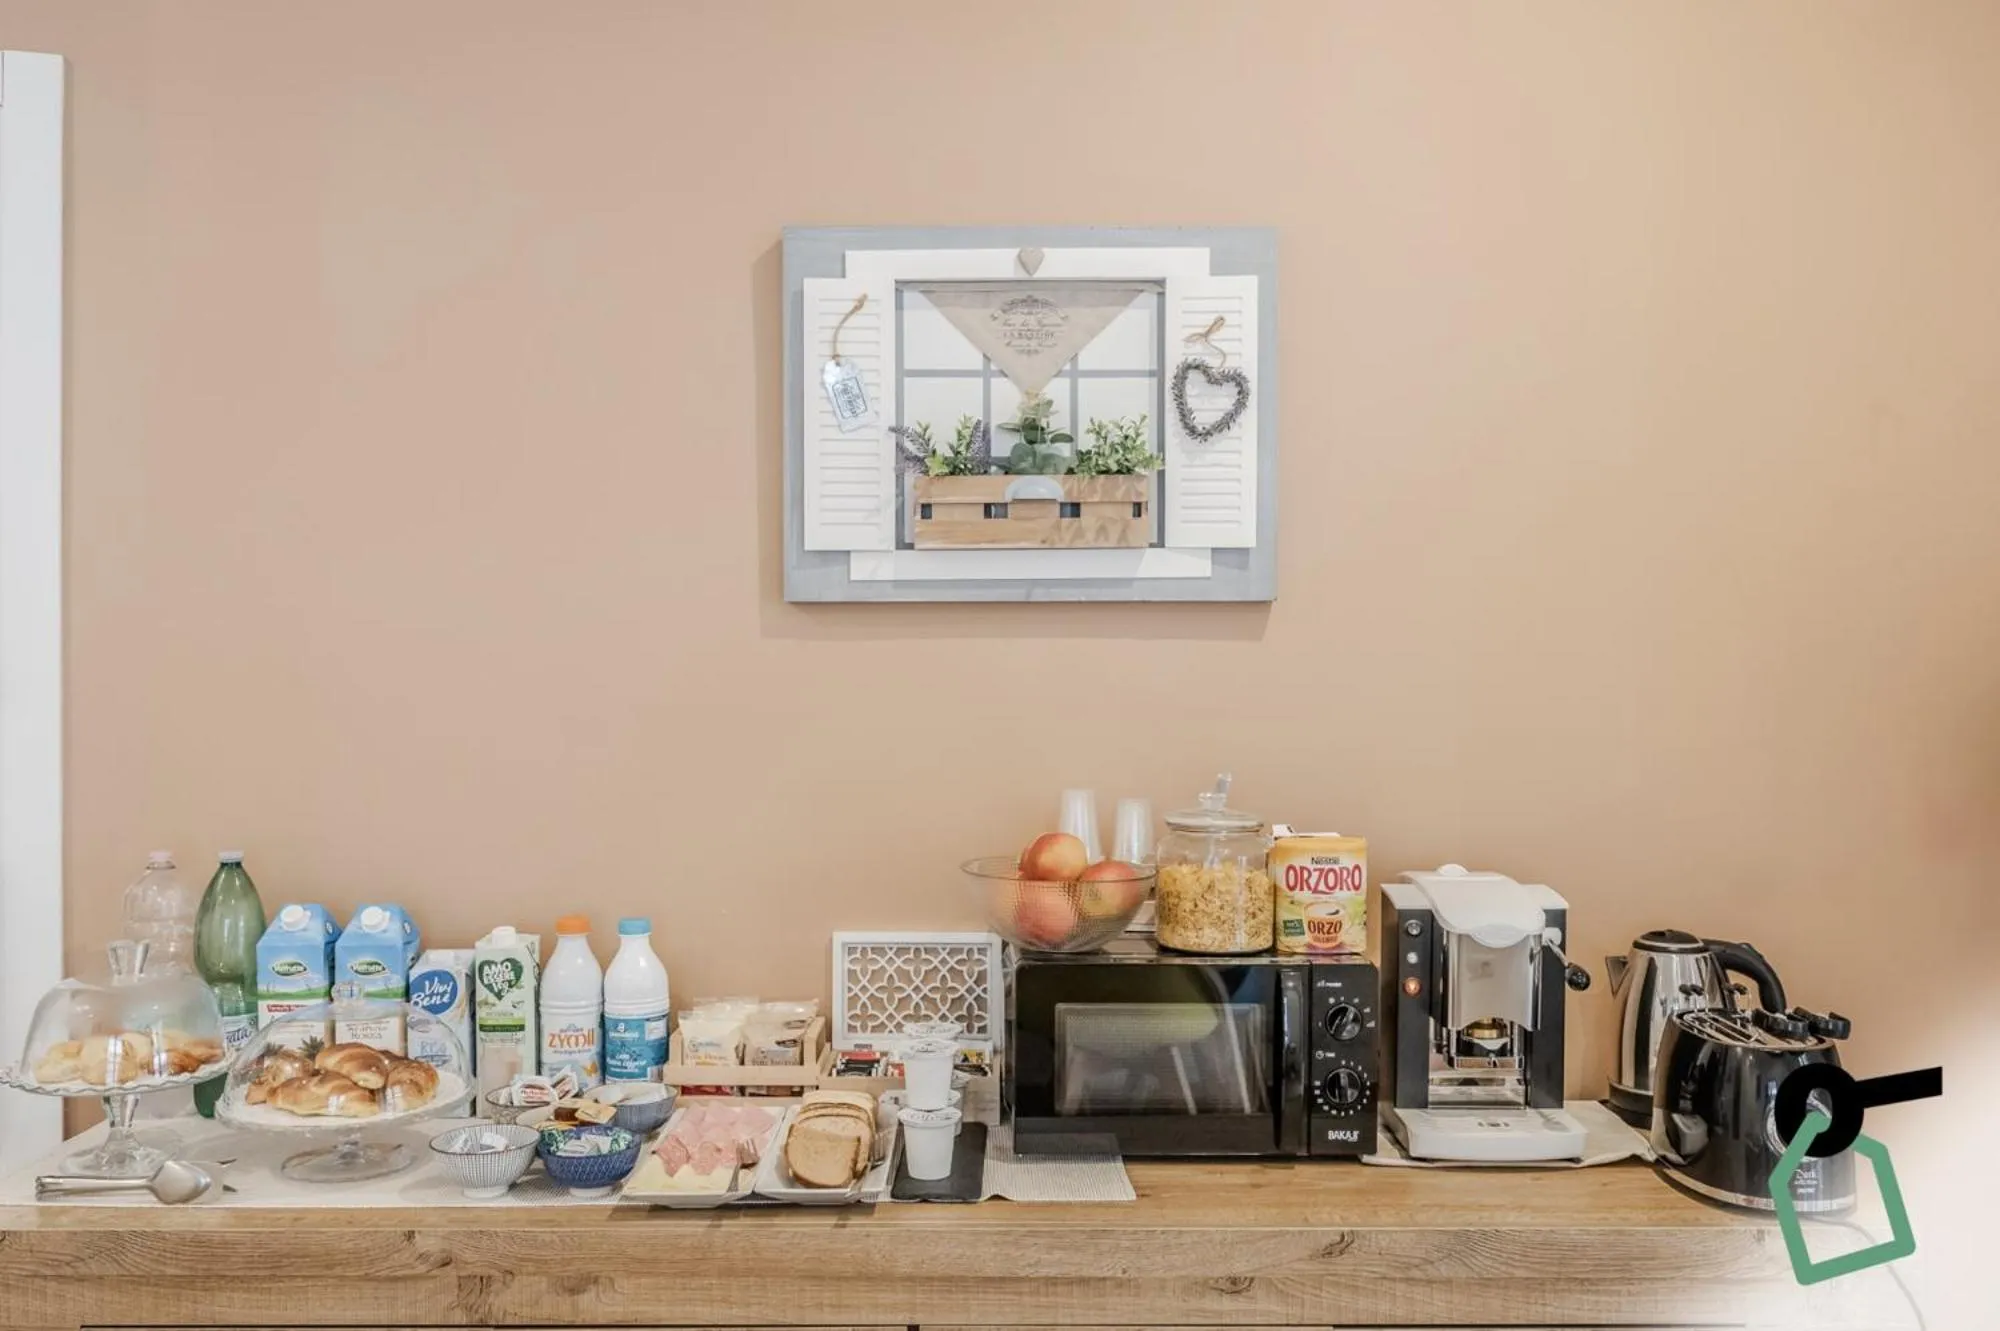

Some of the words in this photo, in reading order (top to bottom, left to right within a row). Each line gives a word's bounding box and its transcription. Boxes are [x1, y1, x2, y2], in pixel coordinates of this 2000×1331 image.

[1285, 864, 1362, 895] ORZORO
[1307, 919, 1342, 935] ORZO
[483, 961, 511, 977] AMO
[425, 977, 453, 994] Vivi
